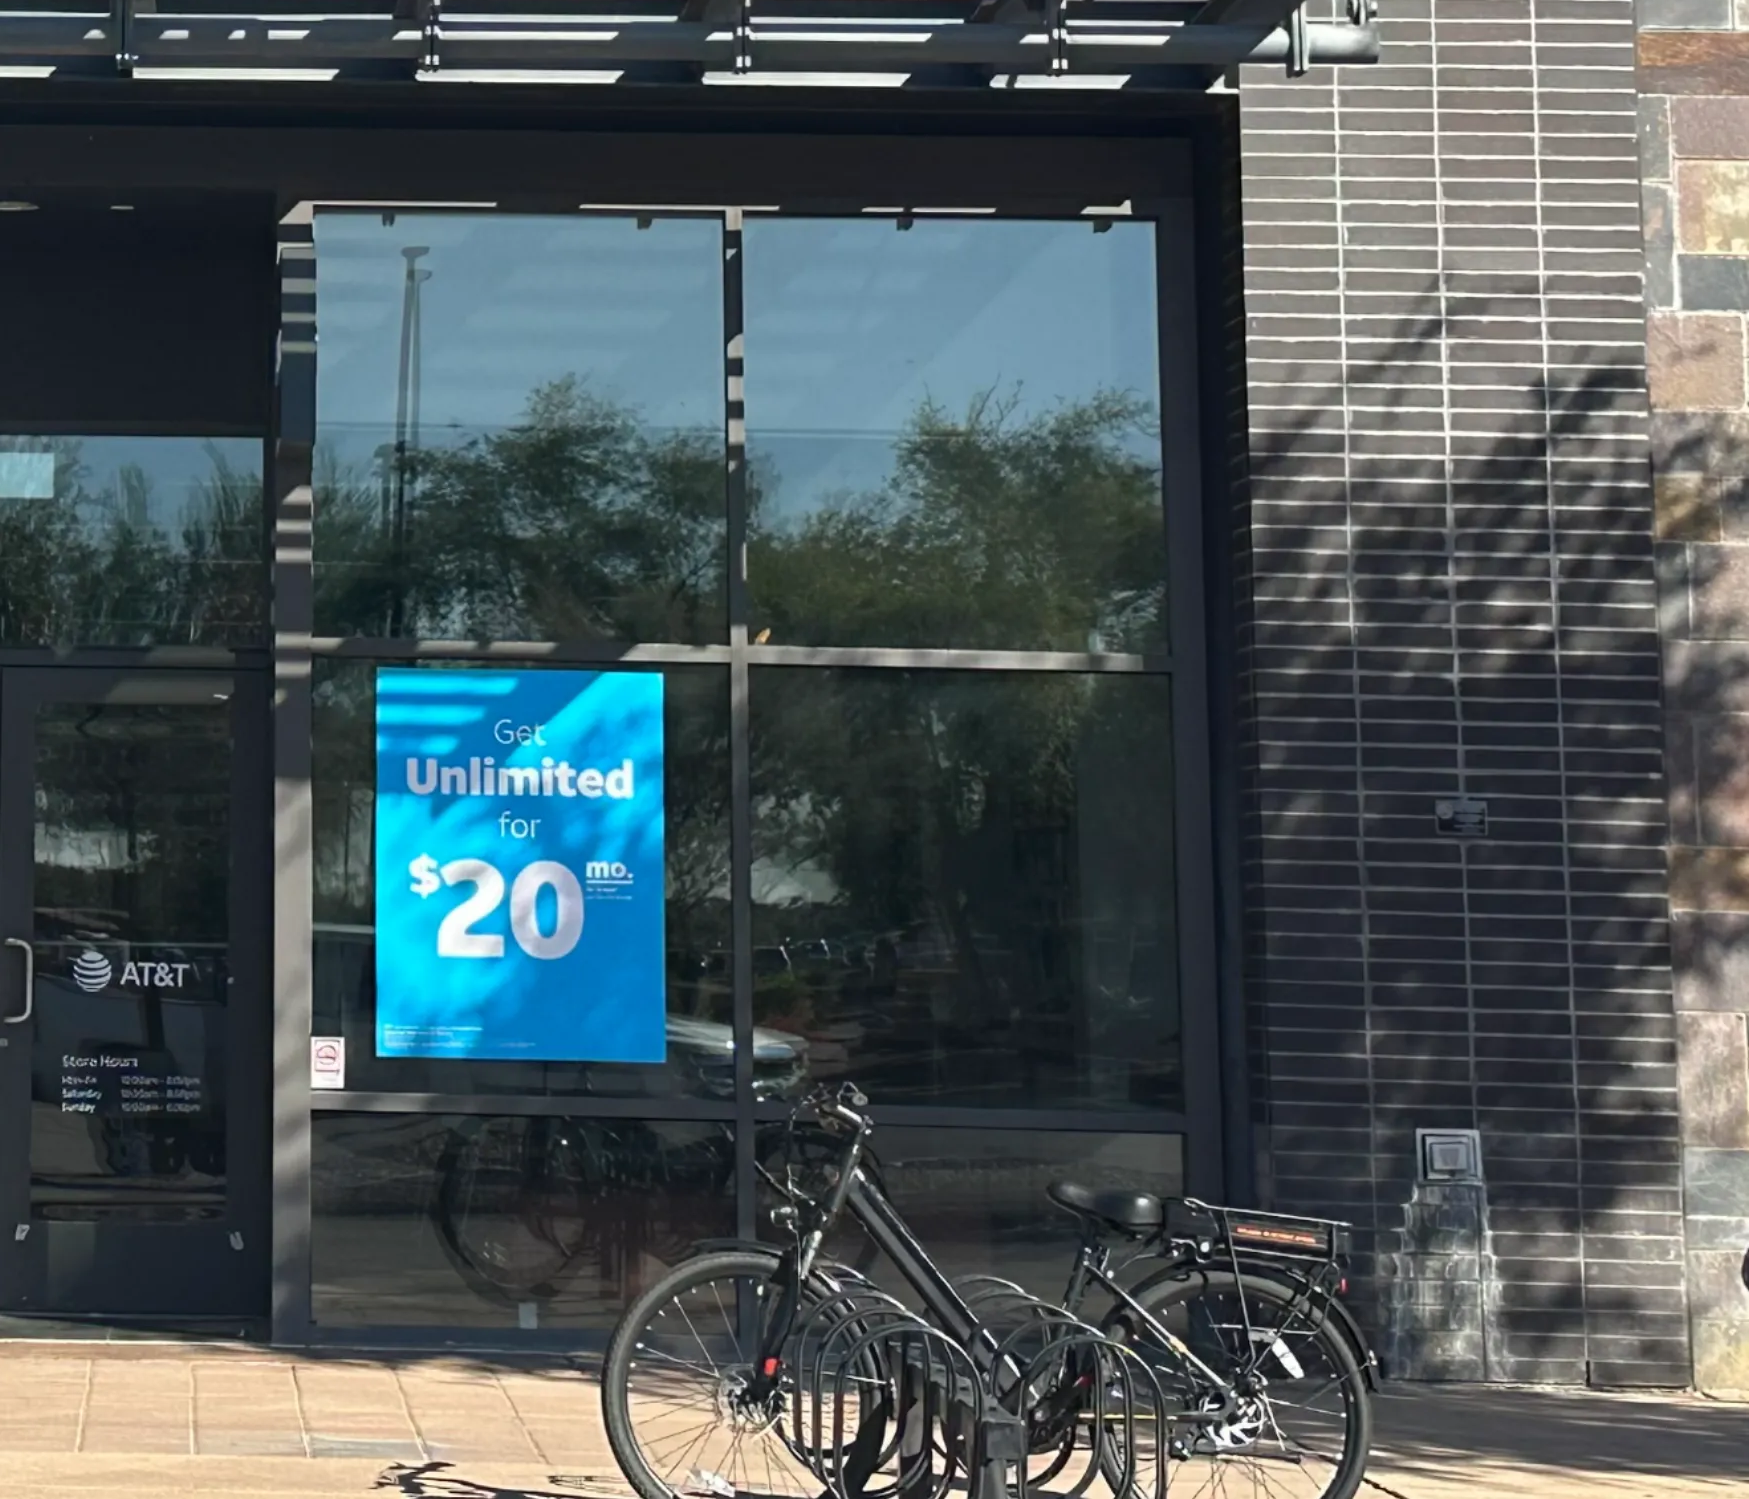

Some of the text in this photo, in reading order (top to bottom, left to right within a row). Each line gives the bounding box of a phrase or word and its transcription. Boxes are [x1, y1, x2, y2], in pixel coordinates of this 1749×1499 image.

[493, 719, 547, 747] Get
[406, 756, 635, 799] Unlimited
[497, 811, 541, 839] for
[408, 853, 585, 960] $20
[119, 961, 191, 988] AT&T
